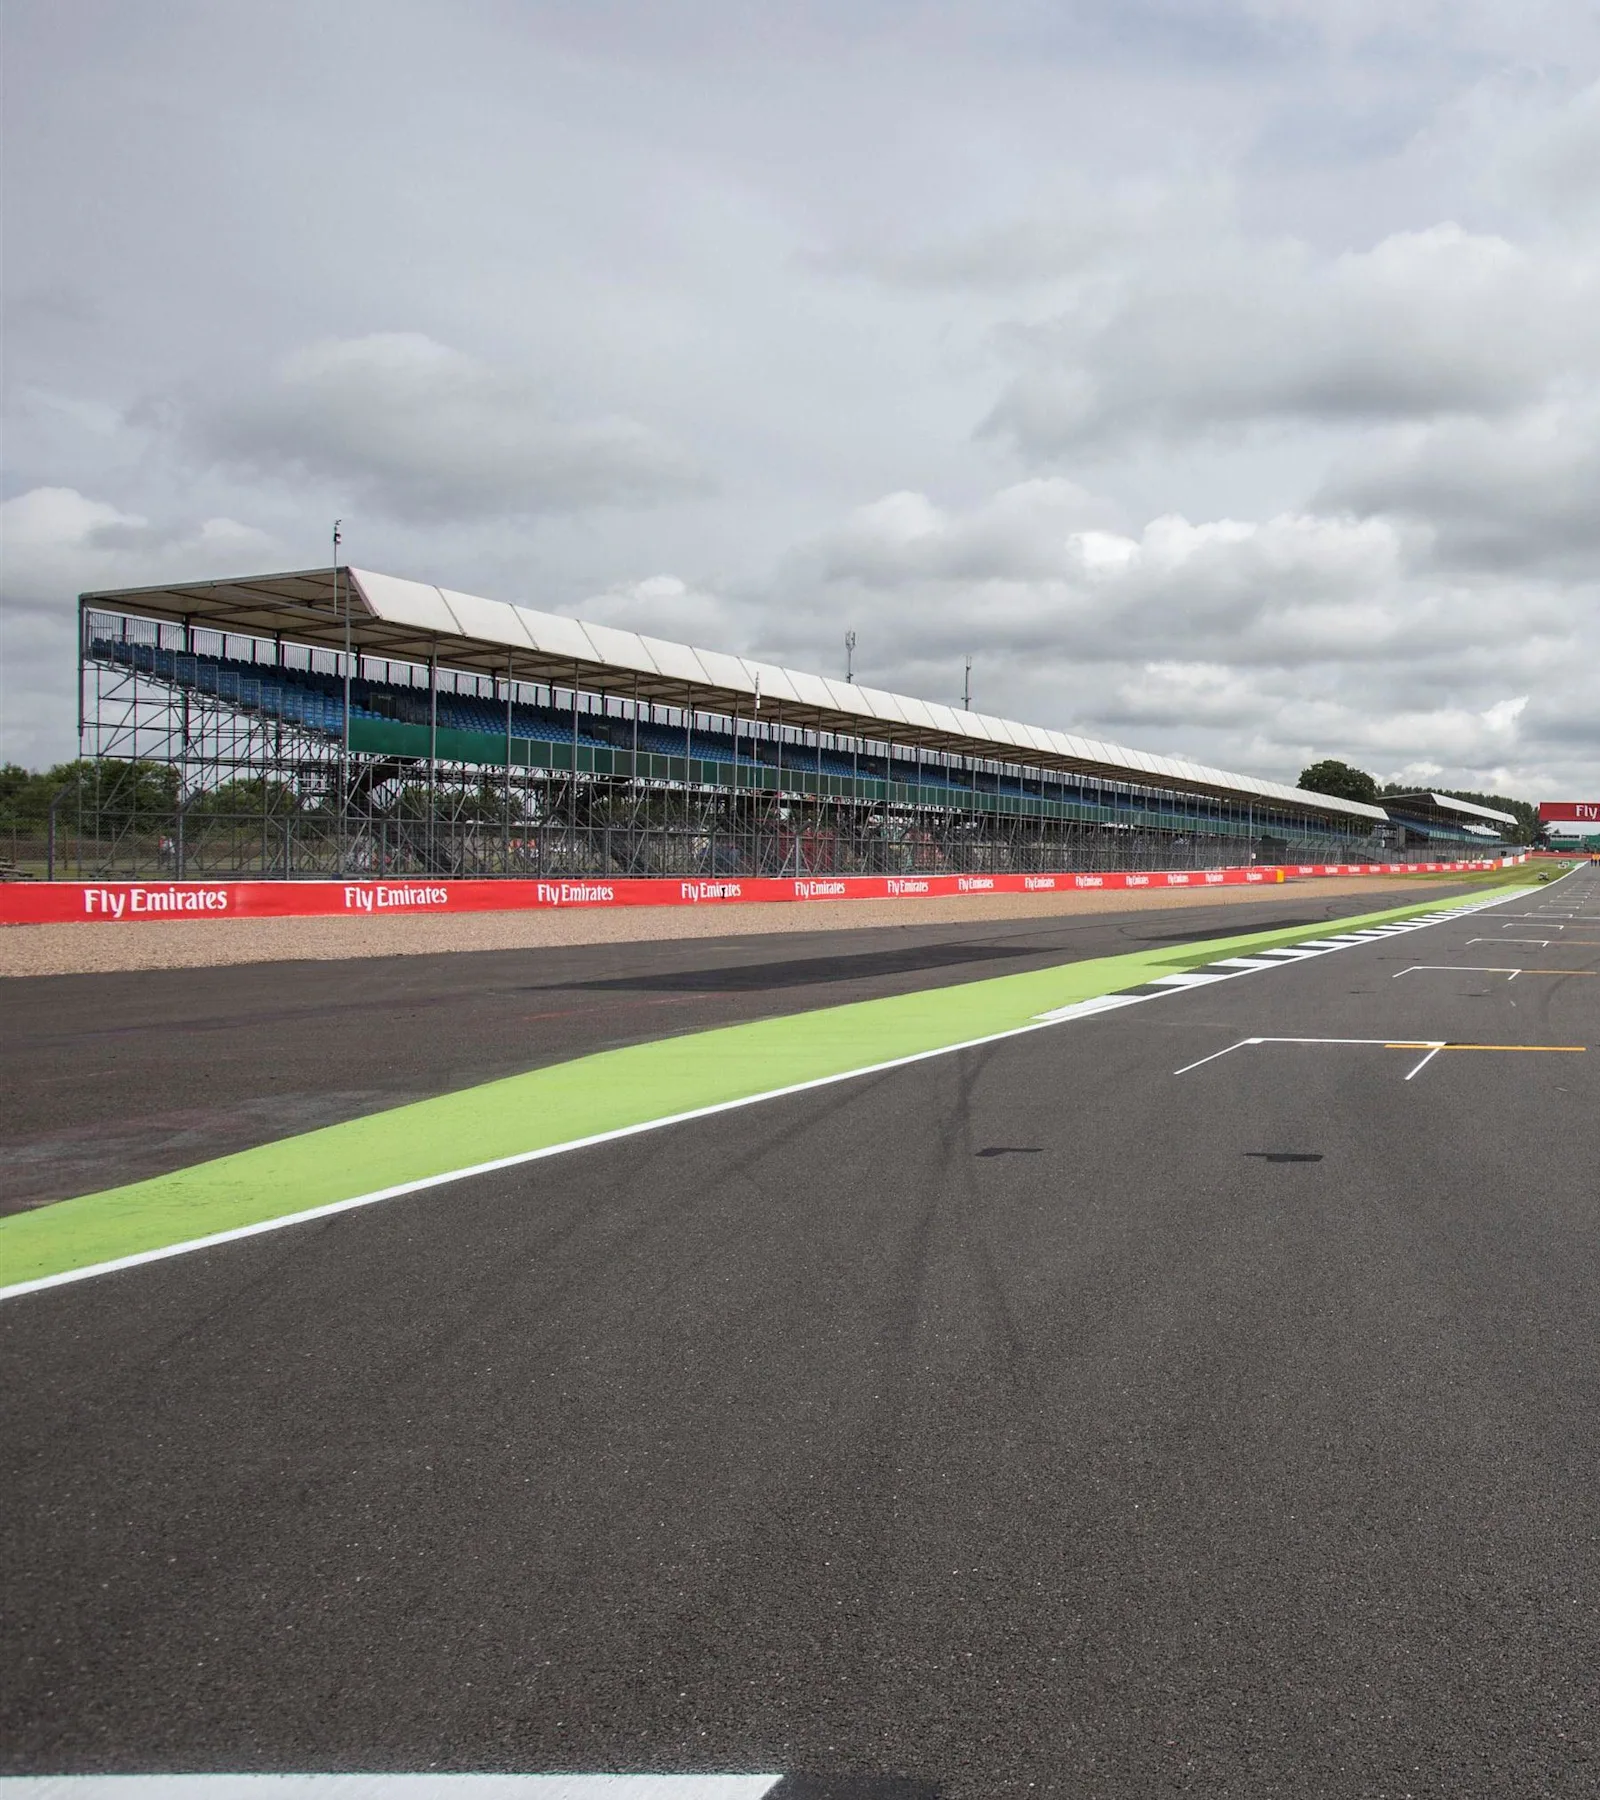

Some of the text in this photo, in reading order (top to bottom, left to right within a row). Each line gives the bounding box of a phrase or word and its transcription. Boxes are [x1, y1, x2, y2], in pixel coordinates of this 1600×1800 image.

[1576, 804, 1598, 820] Fly
[537, 883, 614, 905] Fly Emirates
[681, 882, 741, 902] Fly Emirates
[794, 880, 845, 899] Fly Emirates
[887, 879, 929, 896] Fly Emirates
[959, 877, 994, 892] Fly Emirates
[84, 887, 227, 918] Fly Emirates
[344, 885, 448, 911] Fly Emirates
